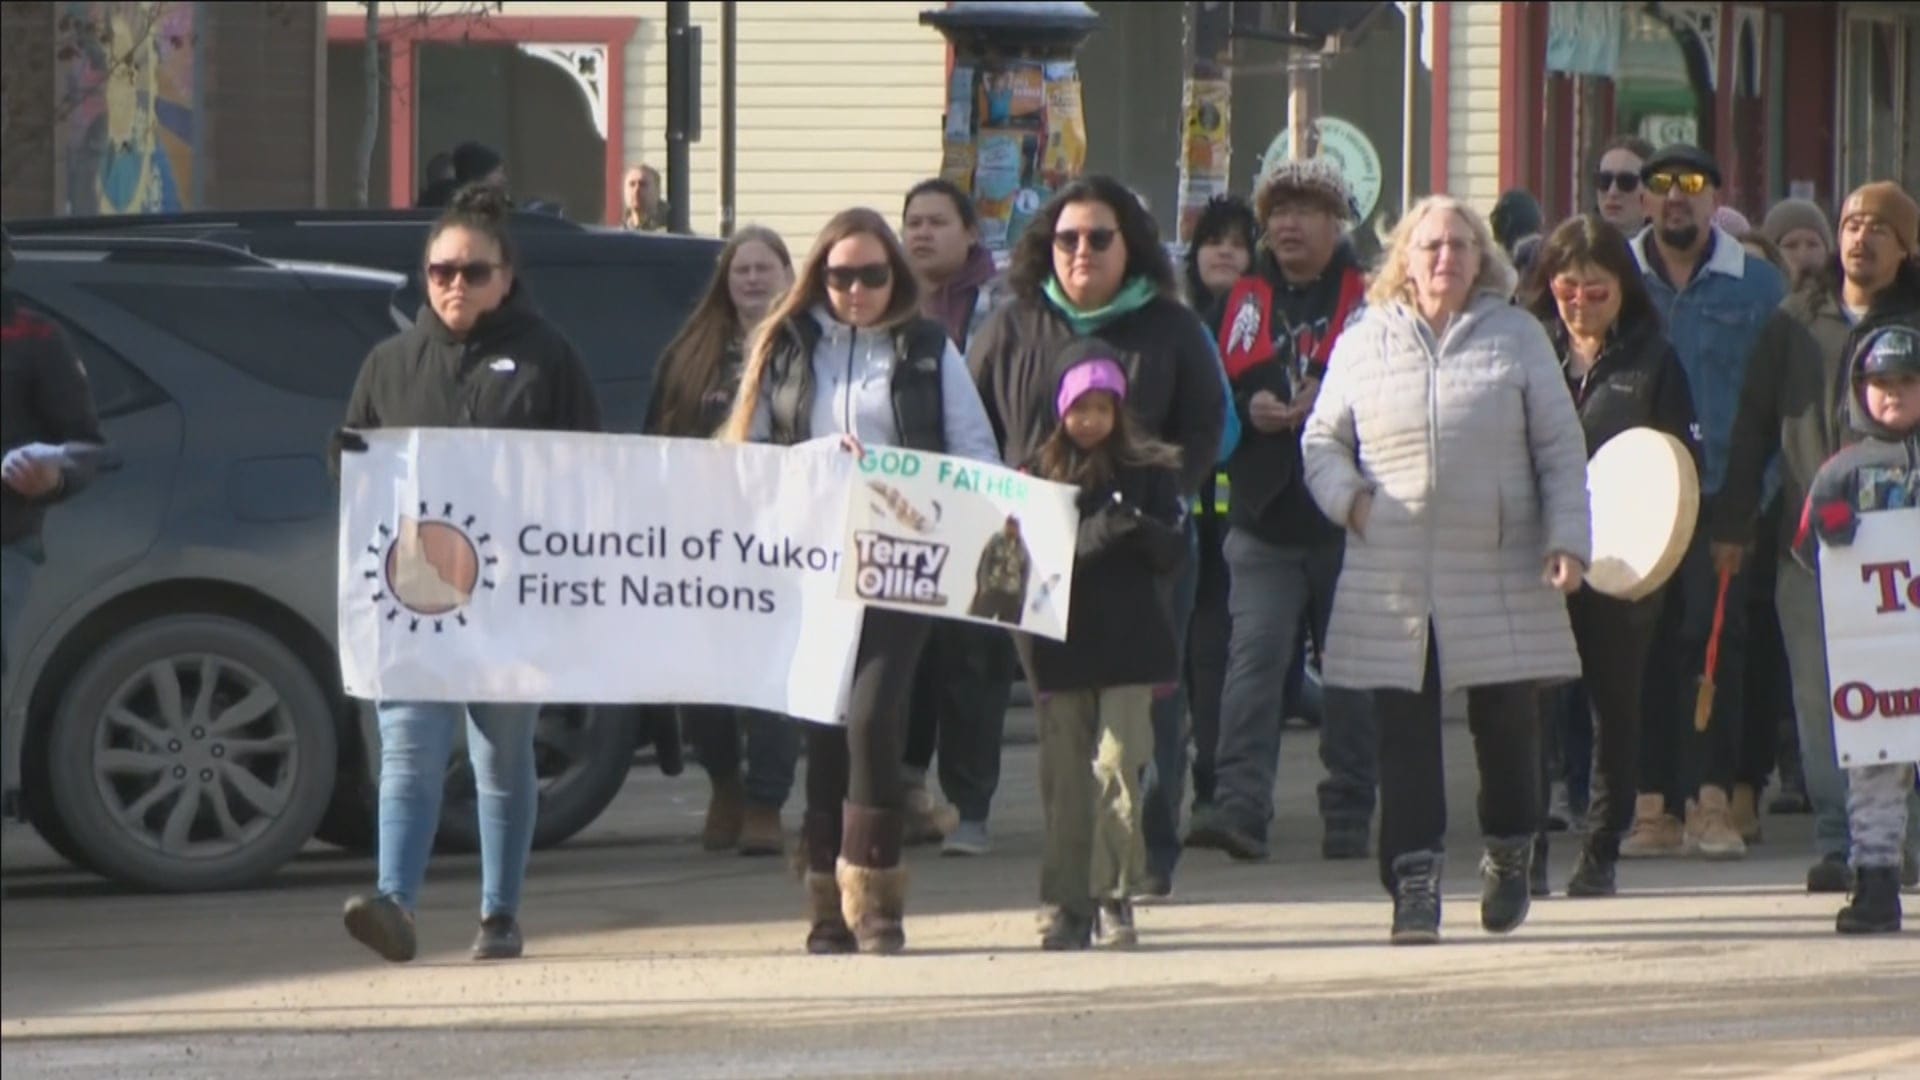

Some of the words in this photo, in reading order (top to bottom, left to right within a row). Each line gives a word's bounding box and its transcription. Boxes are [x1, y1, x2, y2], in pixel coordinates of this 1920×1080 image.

[858, 450, 920, 476] GOD
[938, 462, 1029, 501] FATHER
[518, 525, 666, 558] Council
[682, 530, 723, 560] of
[856, 533, 948, 575] Terry
[518, 574, 605, 606] First
[621, 575, 775, 613] Nations
